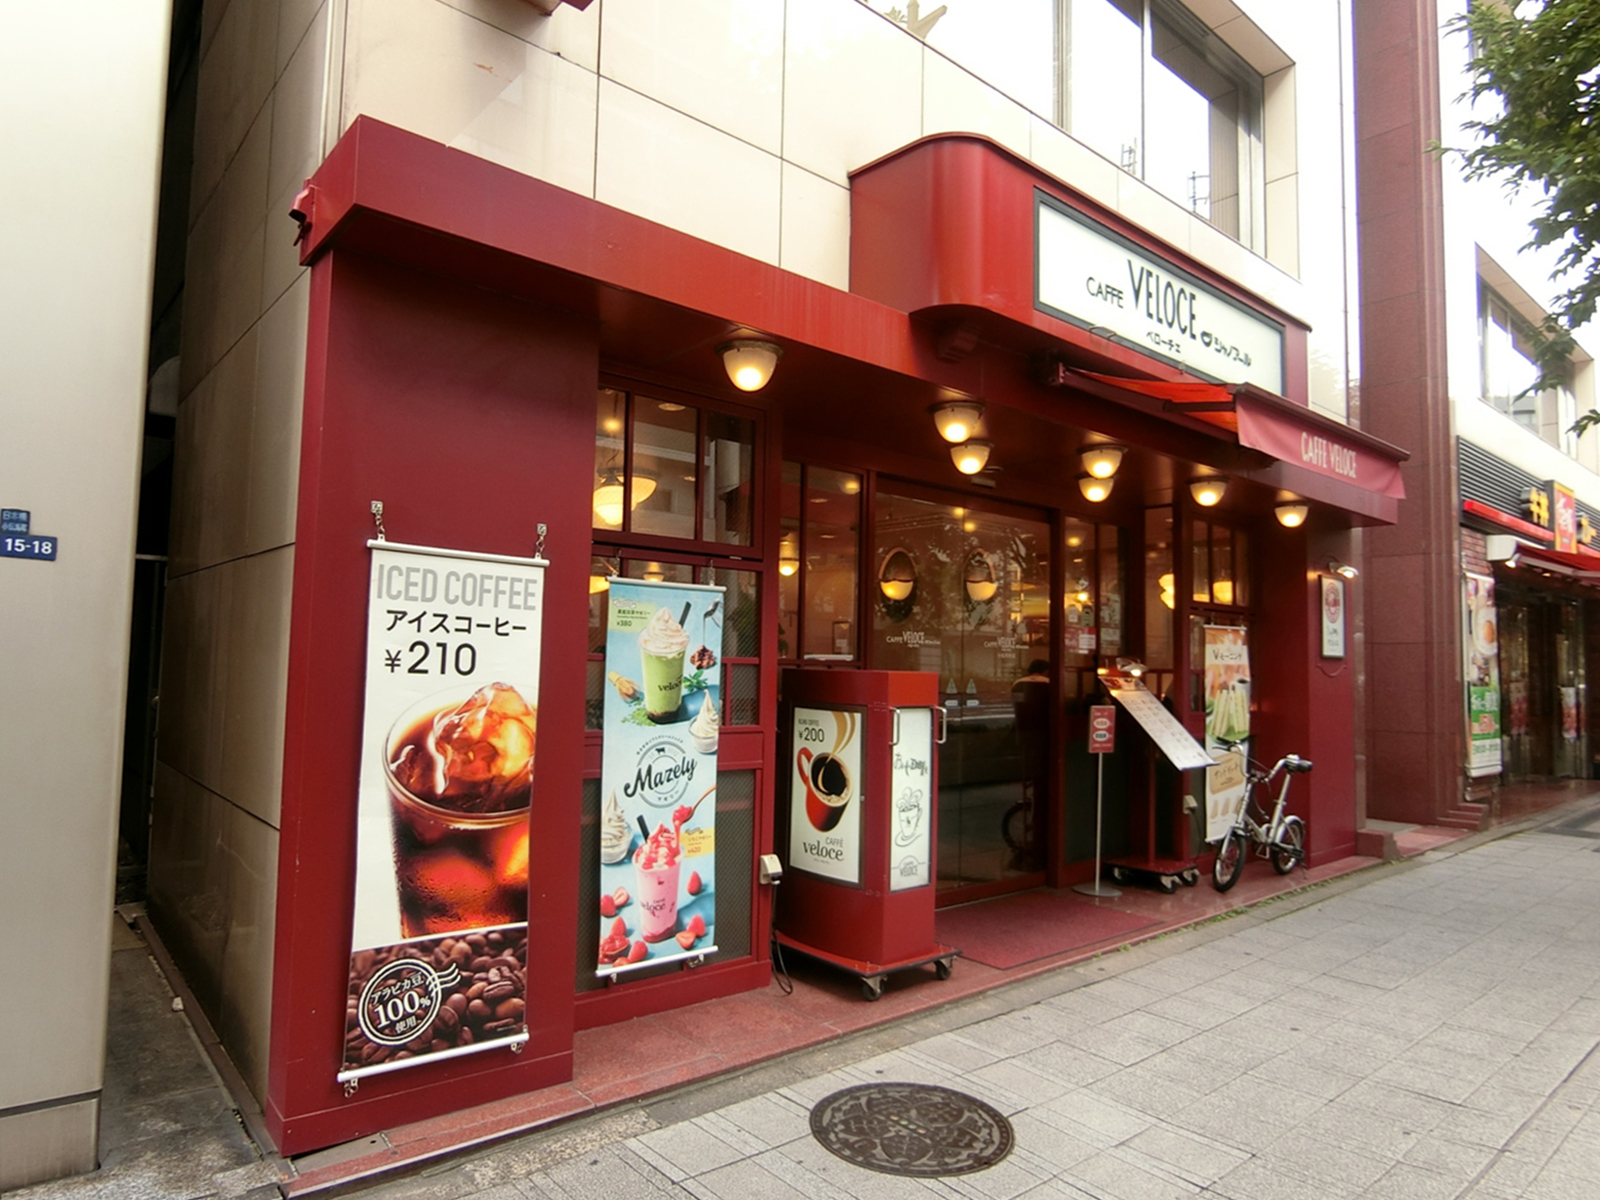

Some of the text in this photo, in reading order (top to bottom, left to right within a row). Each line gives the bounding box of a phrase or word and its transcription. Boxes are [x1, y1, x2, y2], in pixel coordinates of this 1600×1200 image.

[1086, 258, 1197, 340] CAFFE VELOCE
[1328, 441, 1357, 479] VELOCE
[4, 538, 53, 555] 15-18
[376, 563, 538, 611] ICED COFFEE
[385, 609, 527, 637] アイスコーヒー
[385, 640, 477, 676] ¥210
[798, 727, 825, 743] ¥200
[623, 756, 698, 798] Mazely
[803, 841, 844, 861] veloce
[371, 971, 424, 1005] アラビカ豆
[374, 990, 431, 1029] 100%
[395, 1015, 417, 1034] 使用
